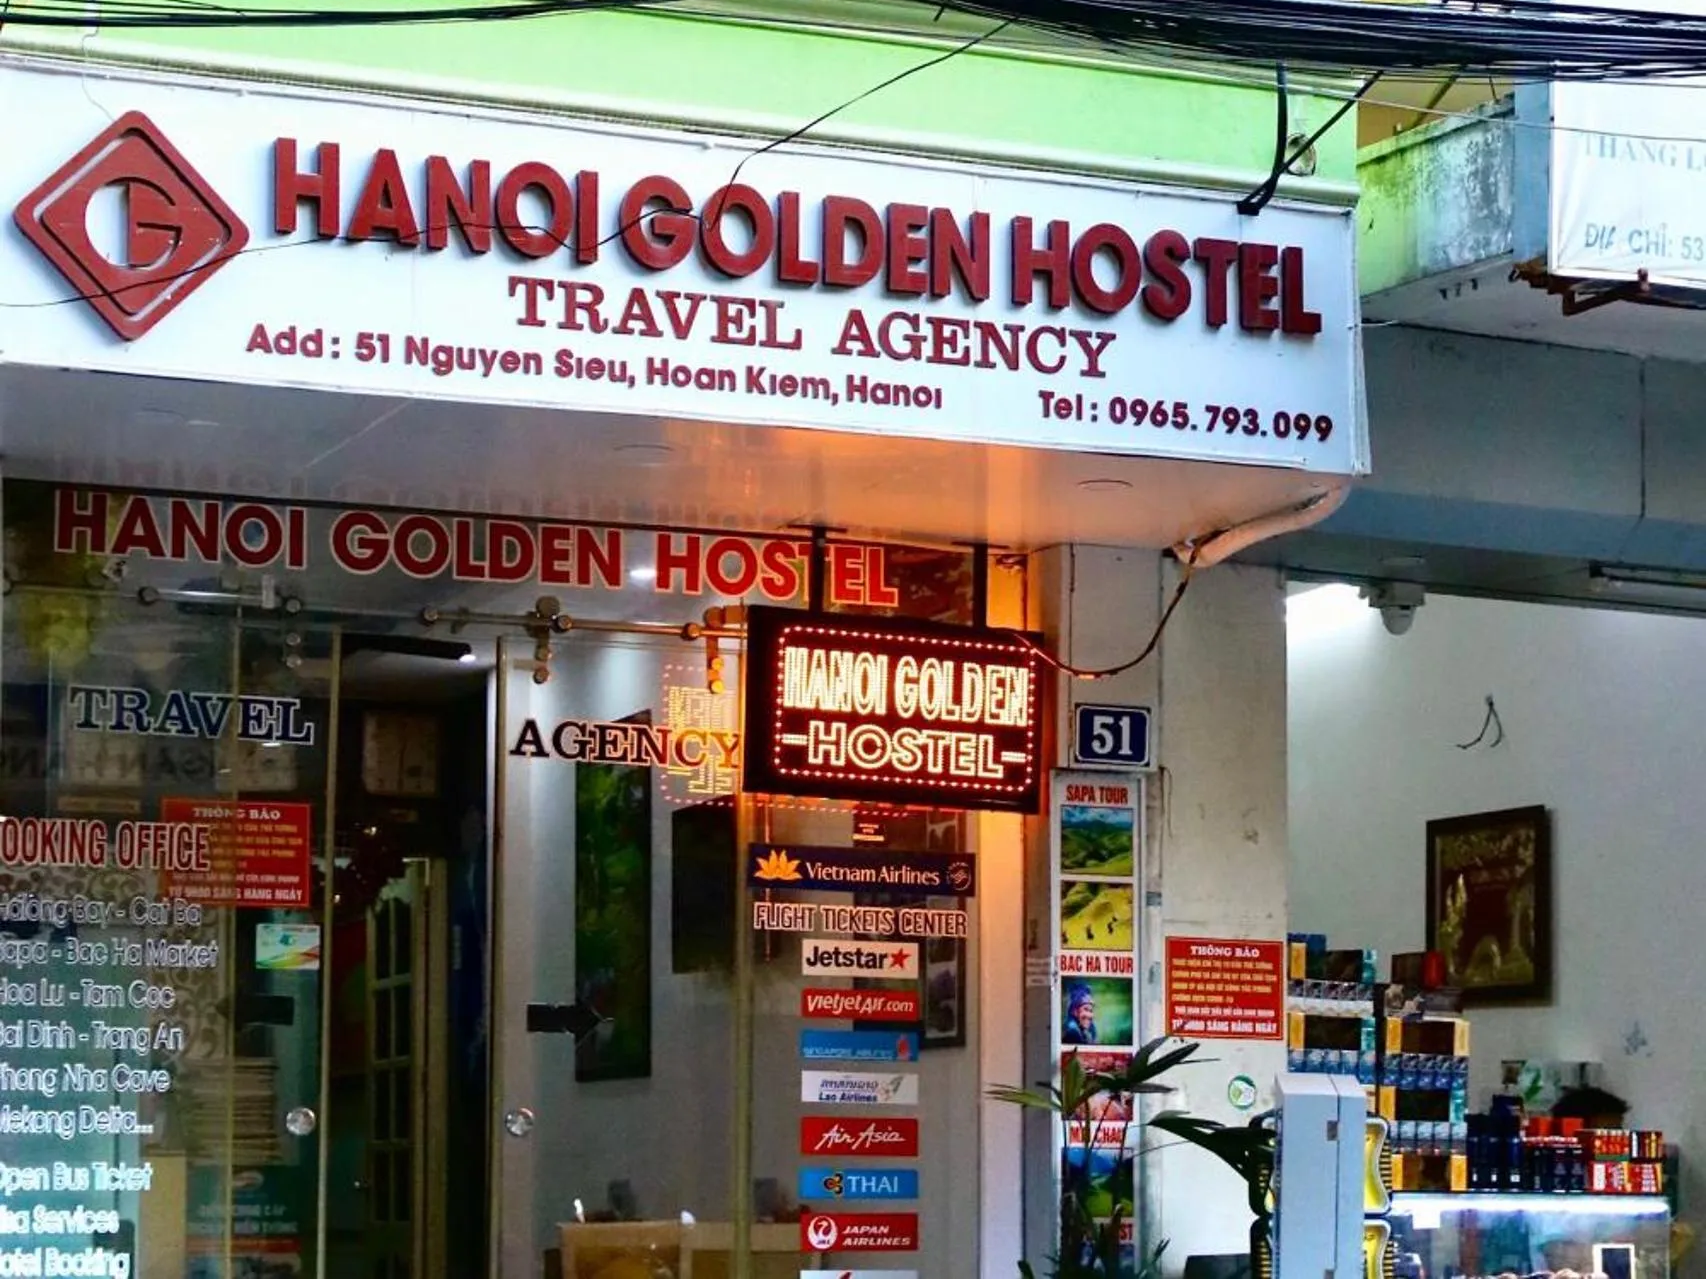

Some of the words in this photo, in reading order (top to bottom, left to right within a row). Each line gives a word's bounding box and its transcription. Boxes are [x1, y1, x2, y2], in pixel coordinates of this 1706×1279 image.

[272, 137, 598, 264] HANOI
[619, 175, 994, 301] GOLDEN
[1009, 215, 1322, 336] HOSTEL
[508, 275, 802, 353] TRAVEL
[832, 309, 1116, 378] AGENCY
[355, 332, 390, 364] 51
[405, 337, 543, 381] Nguyen
[647, 357, 736, 392] Hoan
[846, 375, 942, 409] Hanoi
[1108, 396, 1333, 442] 0965.793.099
[54, 488, 308, 569] HANOI
[330, 510, 622, 589] GOLDEN
[784, 646, 888, 715] HANOI
[895, 655, 1028, 727] GOLDEN
[68, 683, 315, 745] TRAVEL
[509, 716, 741, 770] AGENCY
[807, 720, 1004, 778] HOSTEL
[1091, 715, 1133, 755] 51
[1066, 784, 1096, 802] SAPA
[1098, 786, 1128, 804] TOUR
[115, 822, 211, 871] OFFICE
[805, 861, 876, 883] Vietnam
[877, 865, 940, 886] Airlines
[173, 898, 202, 926] Ba
[753, 902, 817, 931] FLIGHT
[820, 905, 895, 935] TICKETS
[900, 909, 968, 937] CENTER
[65, 936, 108, 965] Bac
[111, 937, 142, 966] Ha
[146, 938, 218, 968] Market
[805, 946, 888, 970] Jetstar
[1060, 954, 1082, 972] BAC
[1086, 955, 1101, 972] HA
[1104, 956, 1133, 973] TOUR
[41, 978, 64, 1007] Lu
[80, 979, 125, 1007] Tam
[27, 1020, 76, 1049] Dinh
[92, 1021, 151, 1056] Trang
[152, 1021, 183, 1050] An
[0, 1062, 58, 1097] hong
[62, 1062, 108, 1092] Nha
[111, 1063, 171, 1093] Cave
[53, 1161, 90, 1191] Bus
[91, 1162, 153, 1191] Ticket
[847, 1175, 898, 1193] THAI
[32, 1204, 120, 1234] Services
[842, 1225, 889, 1235] JAPAN
[842, 1237, 910, 1246] AIRLINES
[0, 1247, 41, 1277] otel
[45, 1247, 130, 1279] Booking
